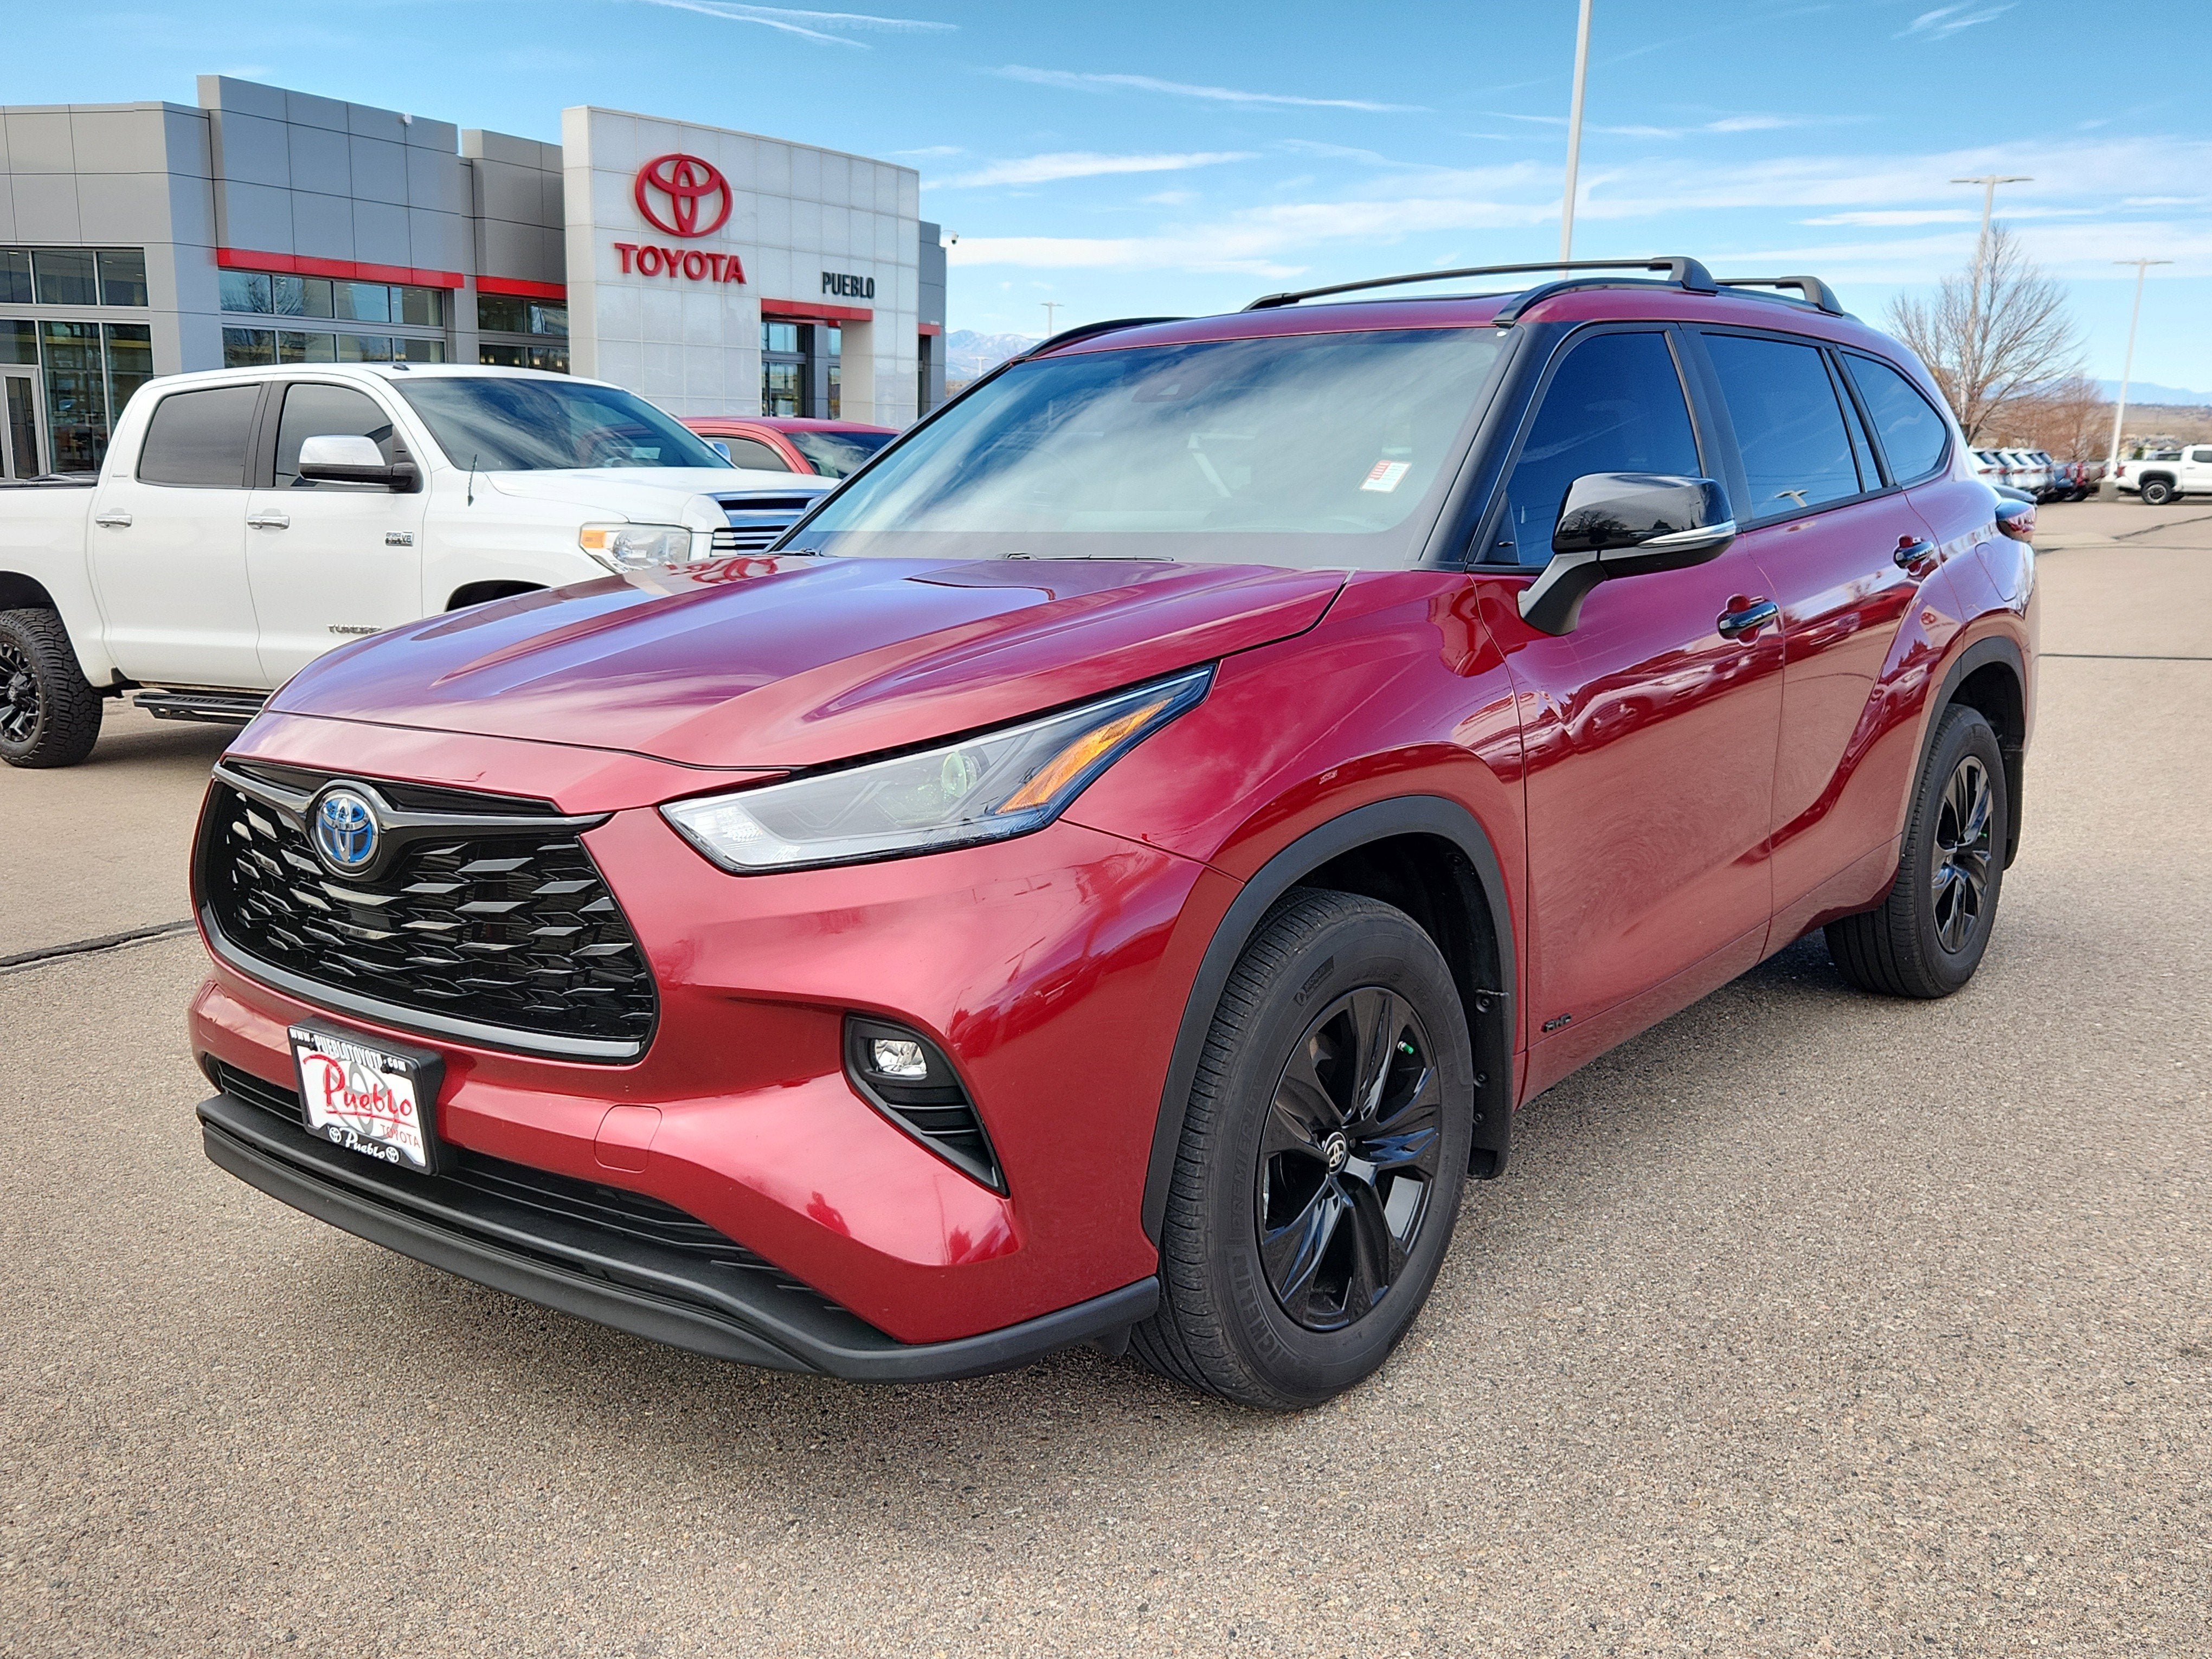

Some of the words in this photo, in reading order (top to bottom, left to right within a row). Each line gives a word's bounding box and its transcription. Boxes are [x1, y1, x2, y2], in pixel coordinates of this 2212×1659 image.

[614, 242, 747, 285] TOYOTA
[821, 271, 876, 299] PUEBLO
[303, 1053, 413, 1116] Pueblo
[340, 1127, 385, 1159] Pueblo
[380, 1124, 421, 1149] TOYOTA
